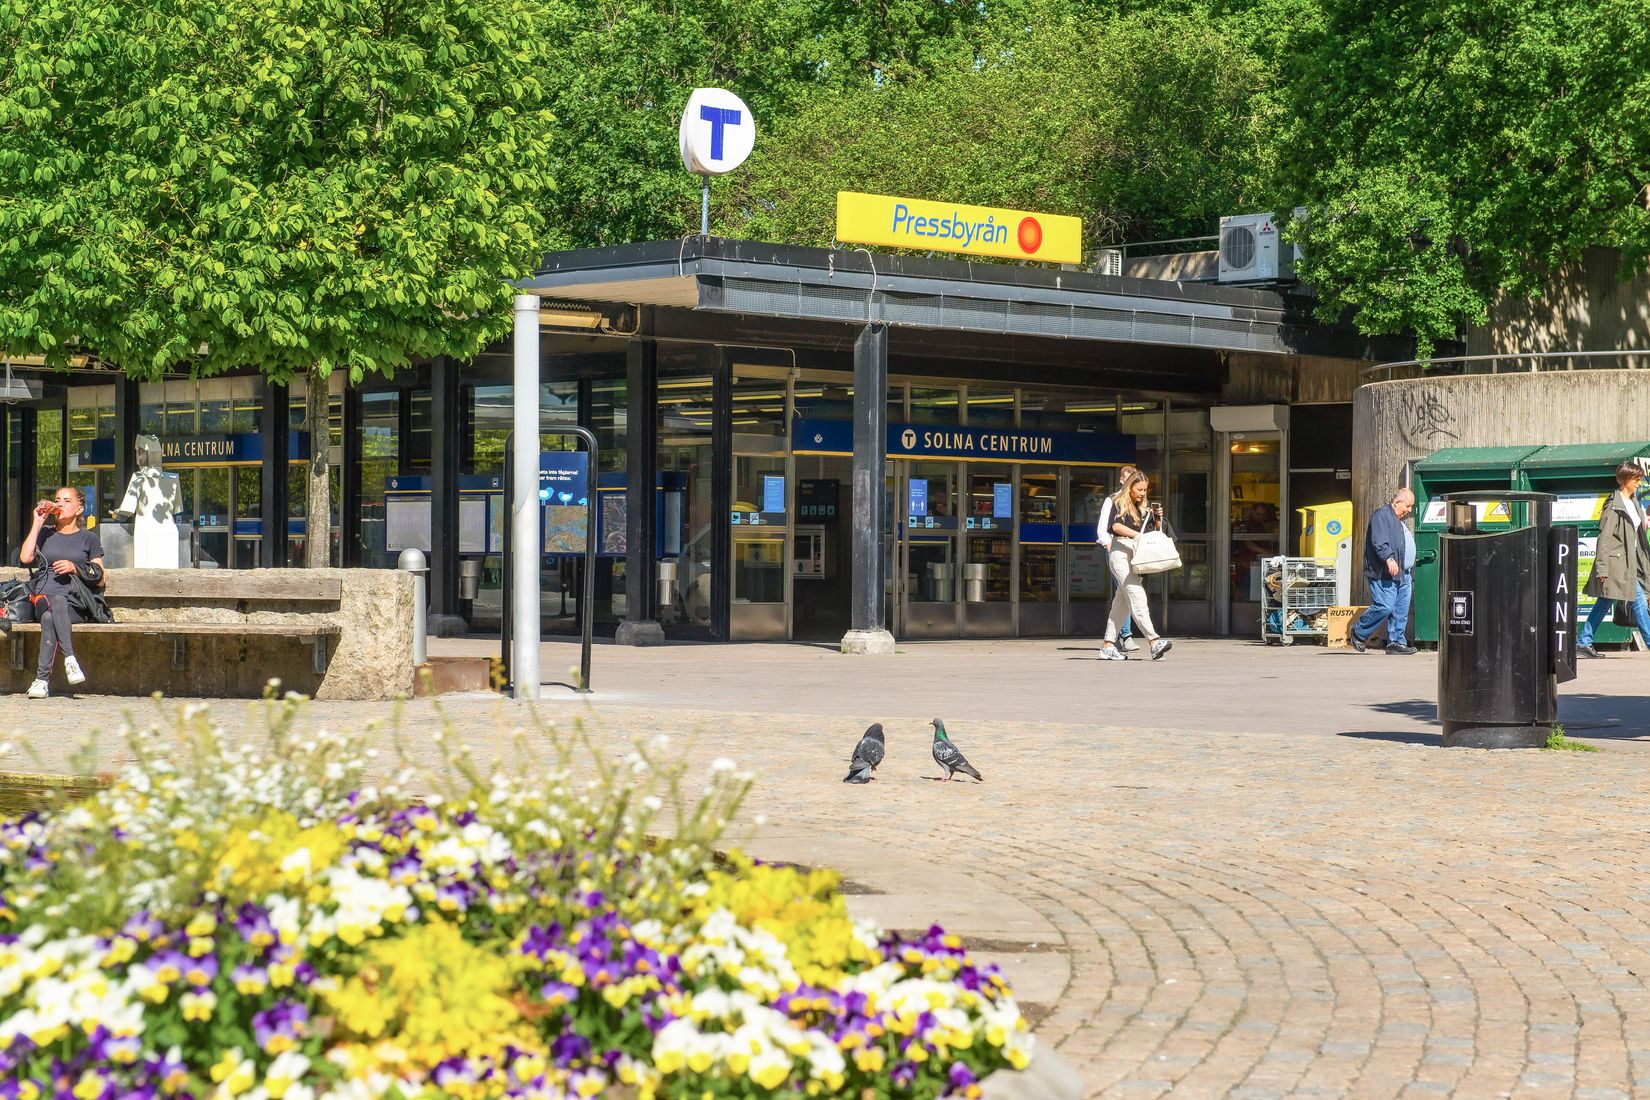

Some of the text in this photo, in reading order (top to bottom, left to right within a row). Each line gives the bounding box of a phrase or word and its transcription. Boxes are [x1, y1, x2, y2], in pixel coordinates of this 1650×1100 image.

[700, 104, 741, 161] T
[892, 203, 1008, 248] Pressbyrån
[161, 440, 234, 457] LNA CENTRUM
[924, 431, 974, 451] SOLNA
[980, 434, 1052, 454] CENTRUM
[1330, 609, 1354, 617] RUSTA
[1556, 543, 1570, 652] PANT
